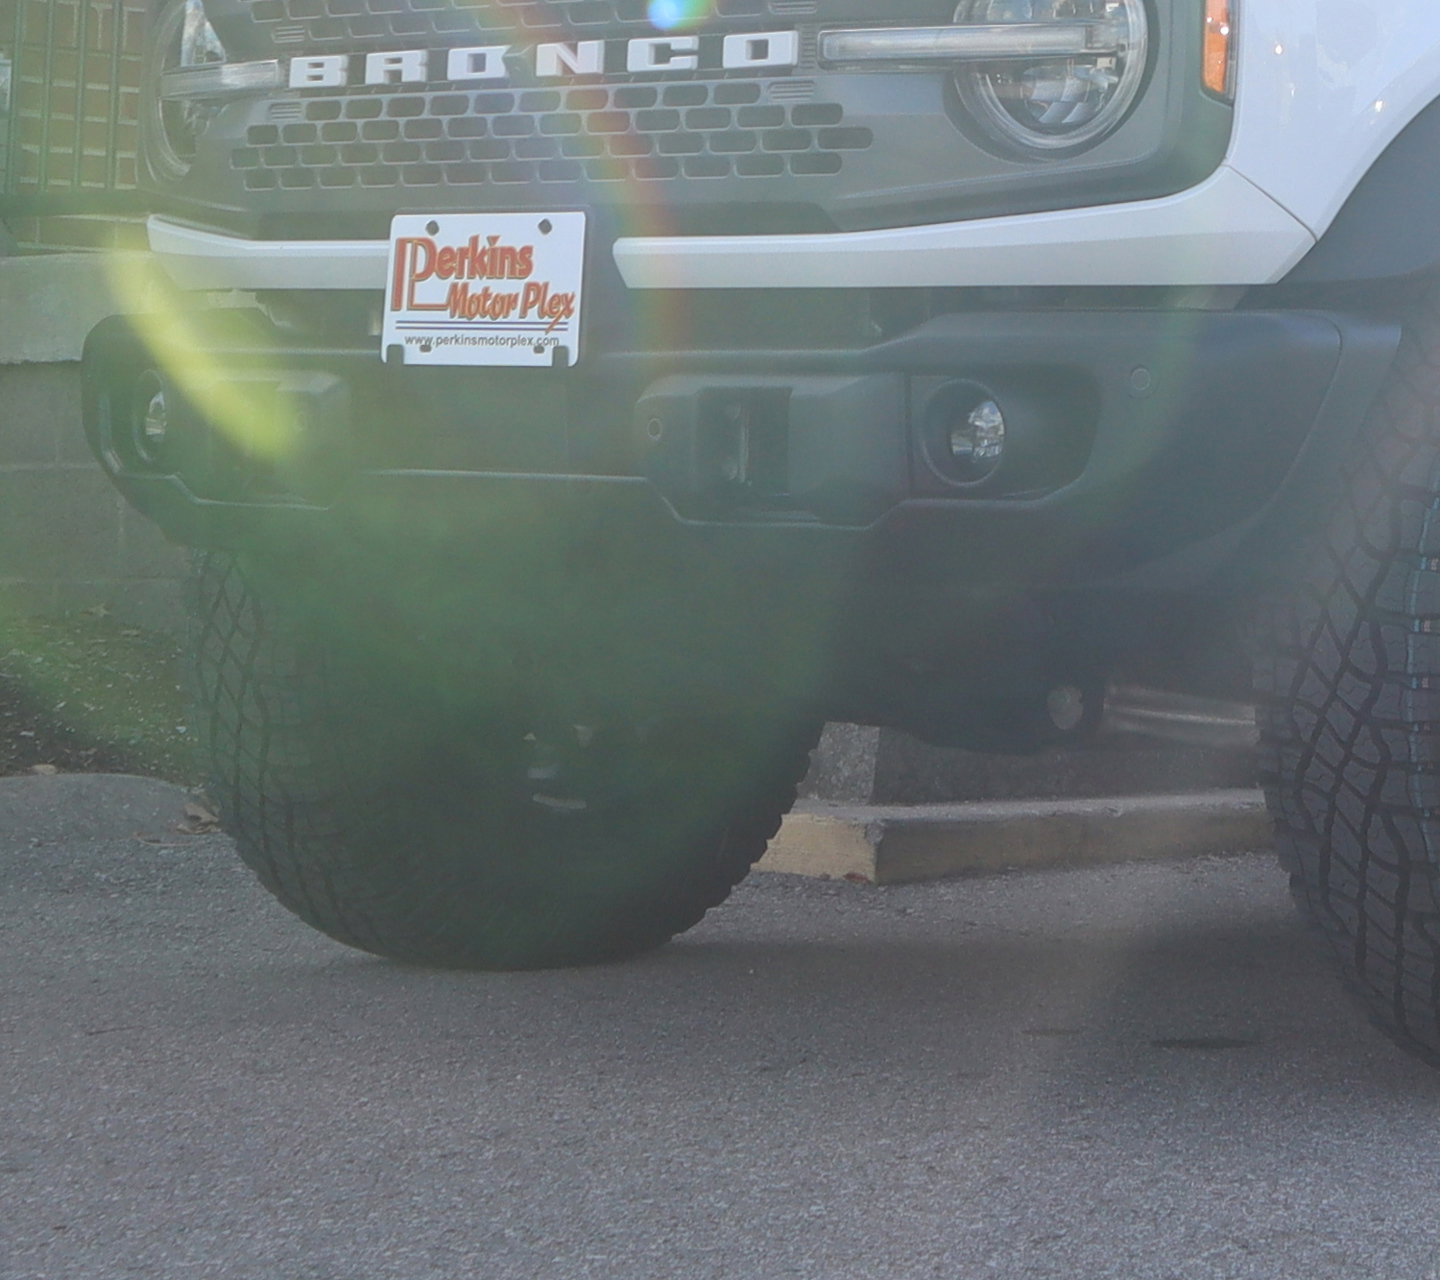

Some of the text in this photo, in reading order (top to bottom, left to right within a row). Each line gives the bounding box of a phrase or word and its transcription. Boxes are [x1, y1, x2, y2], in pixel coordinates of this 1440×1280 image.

[289, 31, 799, 89] BRONCO
[391, 233, 534, 311] Perkins
[449, 281, 575, 334] Motor Plex
[404, 333, 560, 349] www.perkinsmotorplex.com
